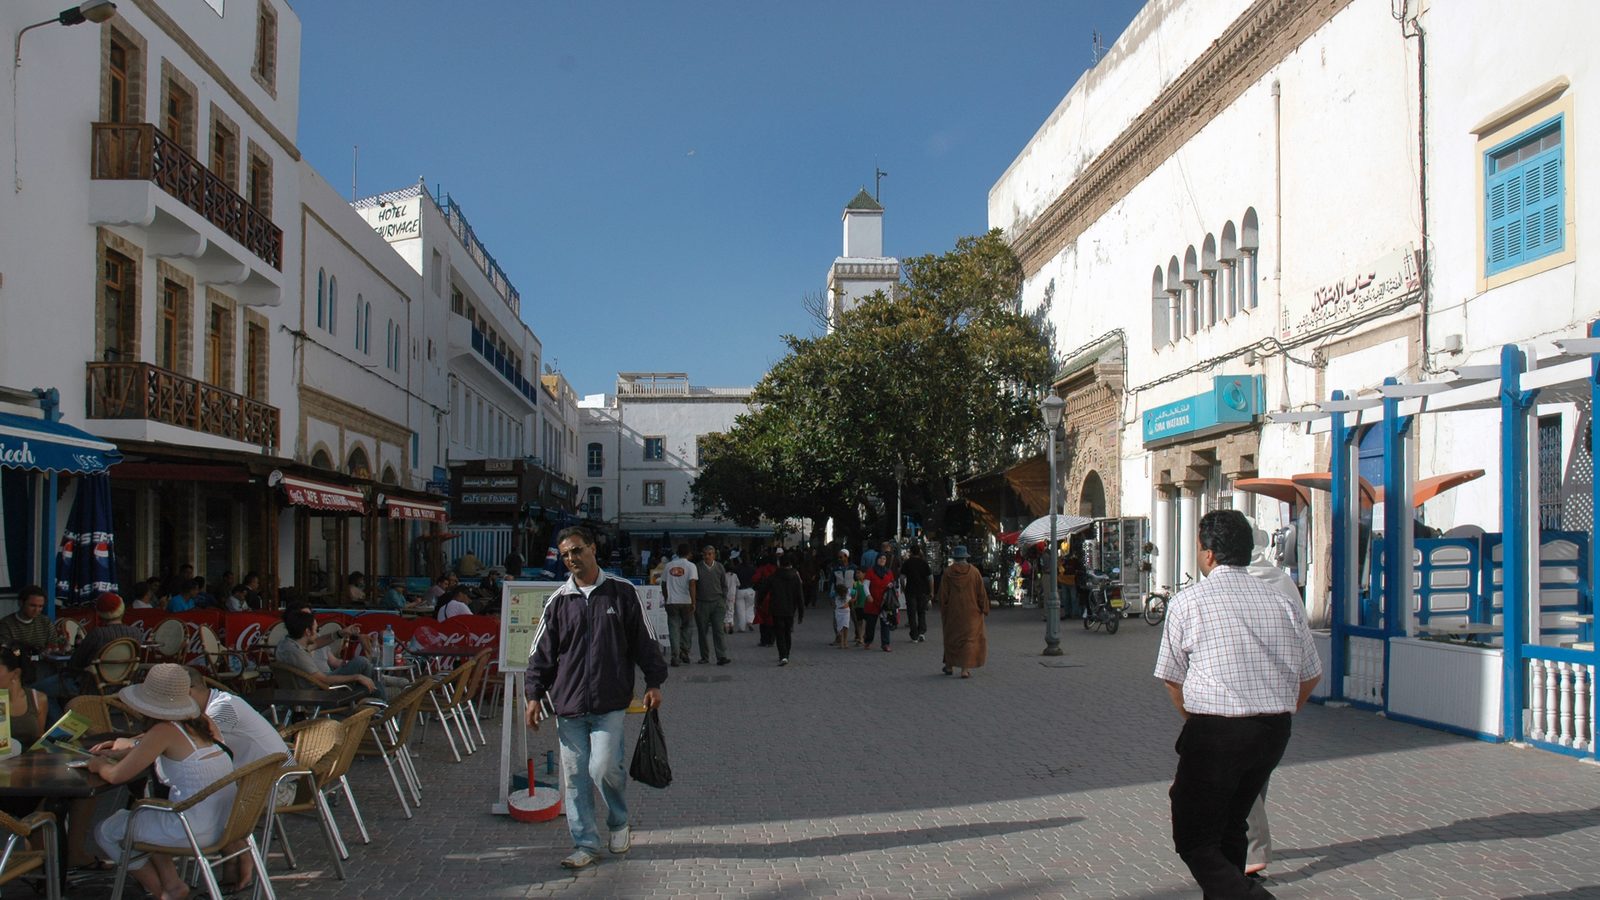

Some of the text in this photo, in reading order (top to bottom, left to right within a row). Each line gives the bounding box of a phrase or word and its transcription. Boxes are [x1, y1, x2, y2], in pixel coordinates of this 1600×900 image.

[378, 205, 407, 222] HOTEL
[375, 218, 420, 238] AURIVAGE
[489, 494, 516, 503] FRANCE
